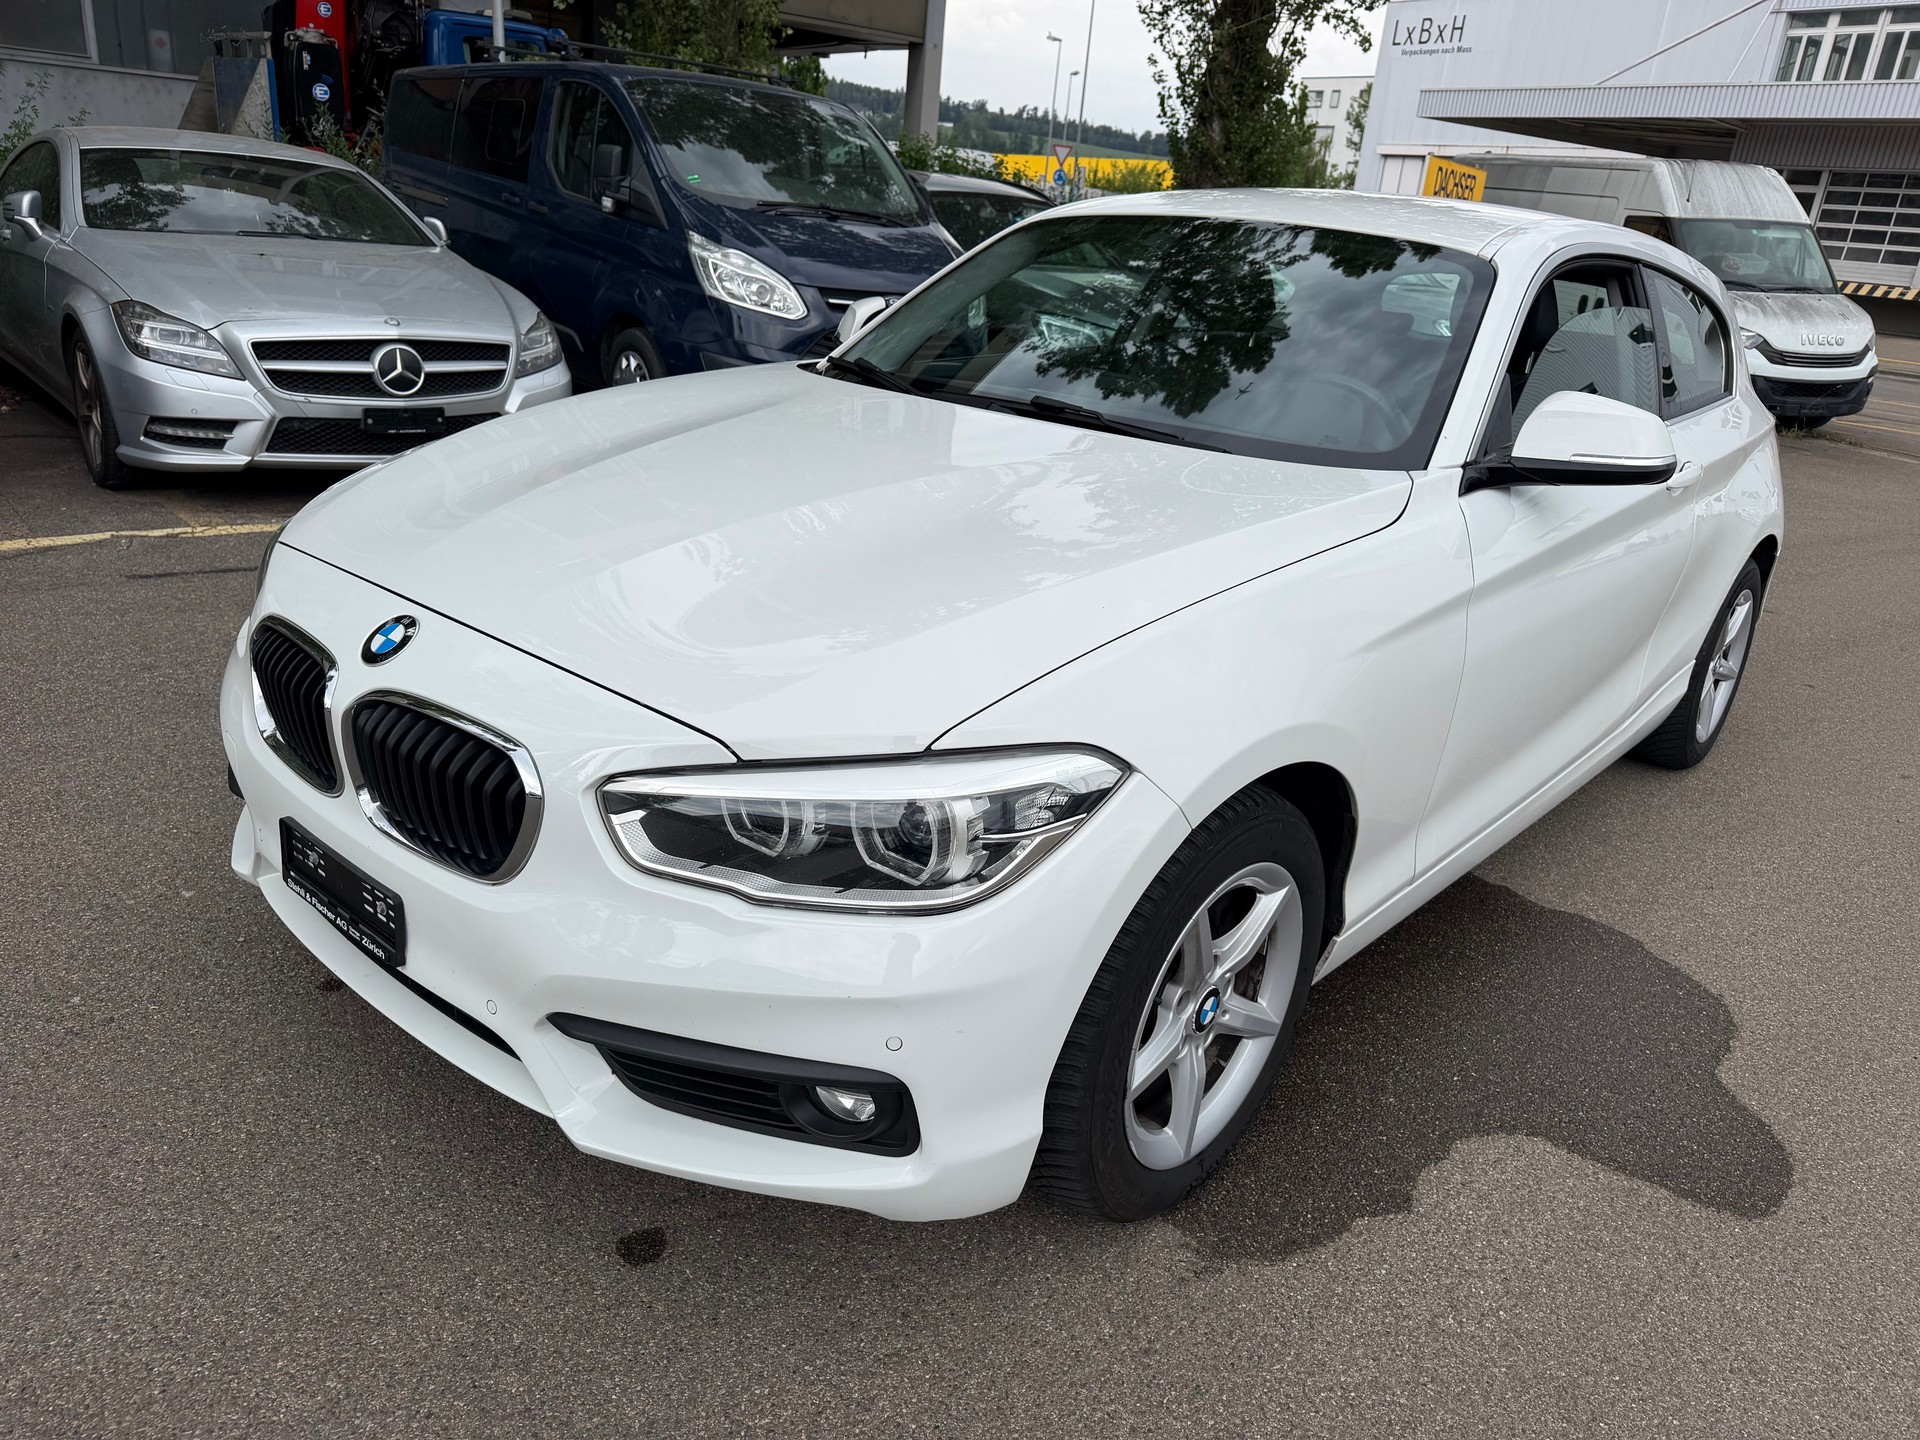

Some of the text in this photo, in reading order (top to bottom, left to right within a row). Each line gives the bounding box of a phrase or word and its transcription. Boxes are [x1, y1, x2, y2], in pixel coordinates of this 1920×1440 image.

[1392, 14, 1467, 46] LxBxH
[1401, 45, 1473, 57] Verpackungen nach Mass
[1433, 166, 1477, 202] DACHSER
[1801, 333, 1845, 347] IVECO
[287, 878, 386, 960] Stehli & Fischer AG Zürich
